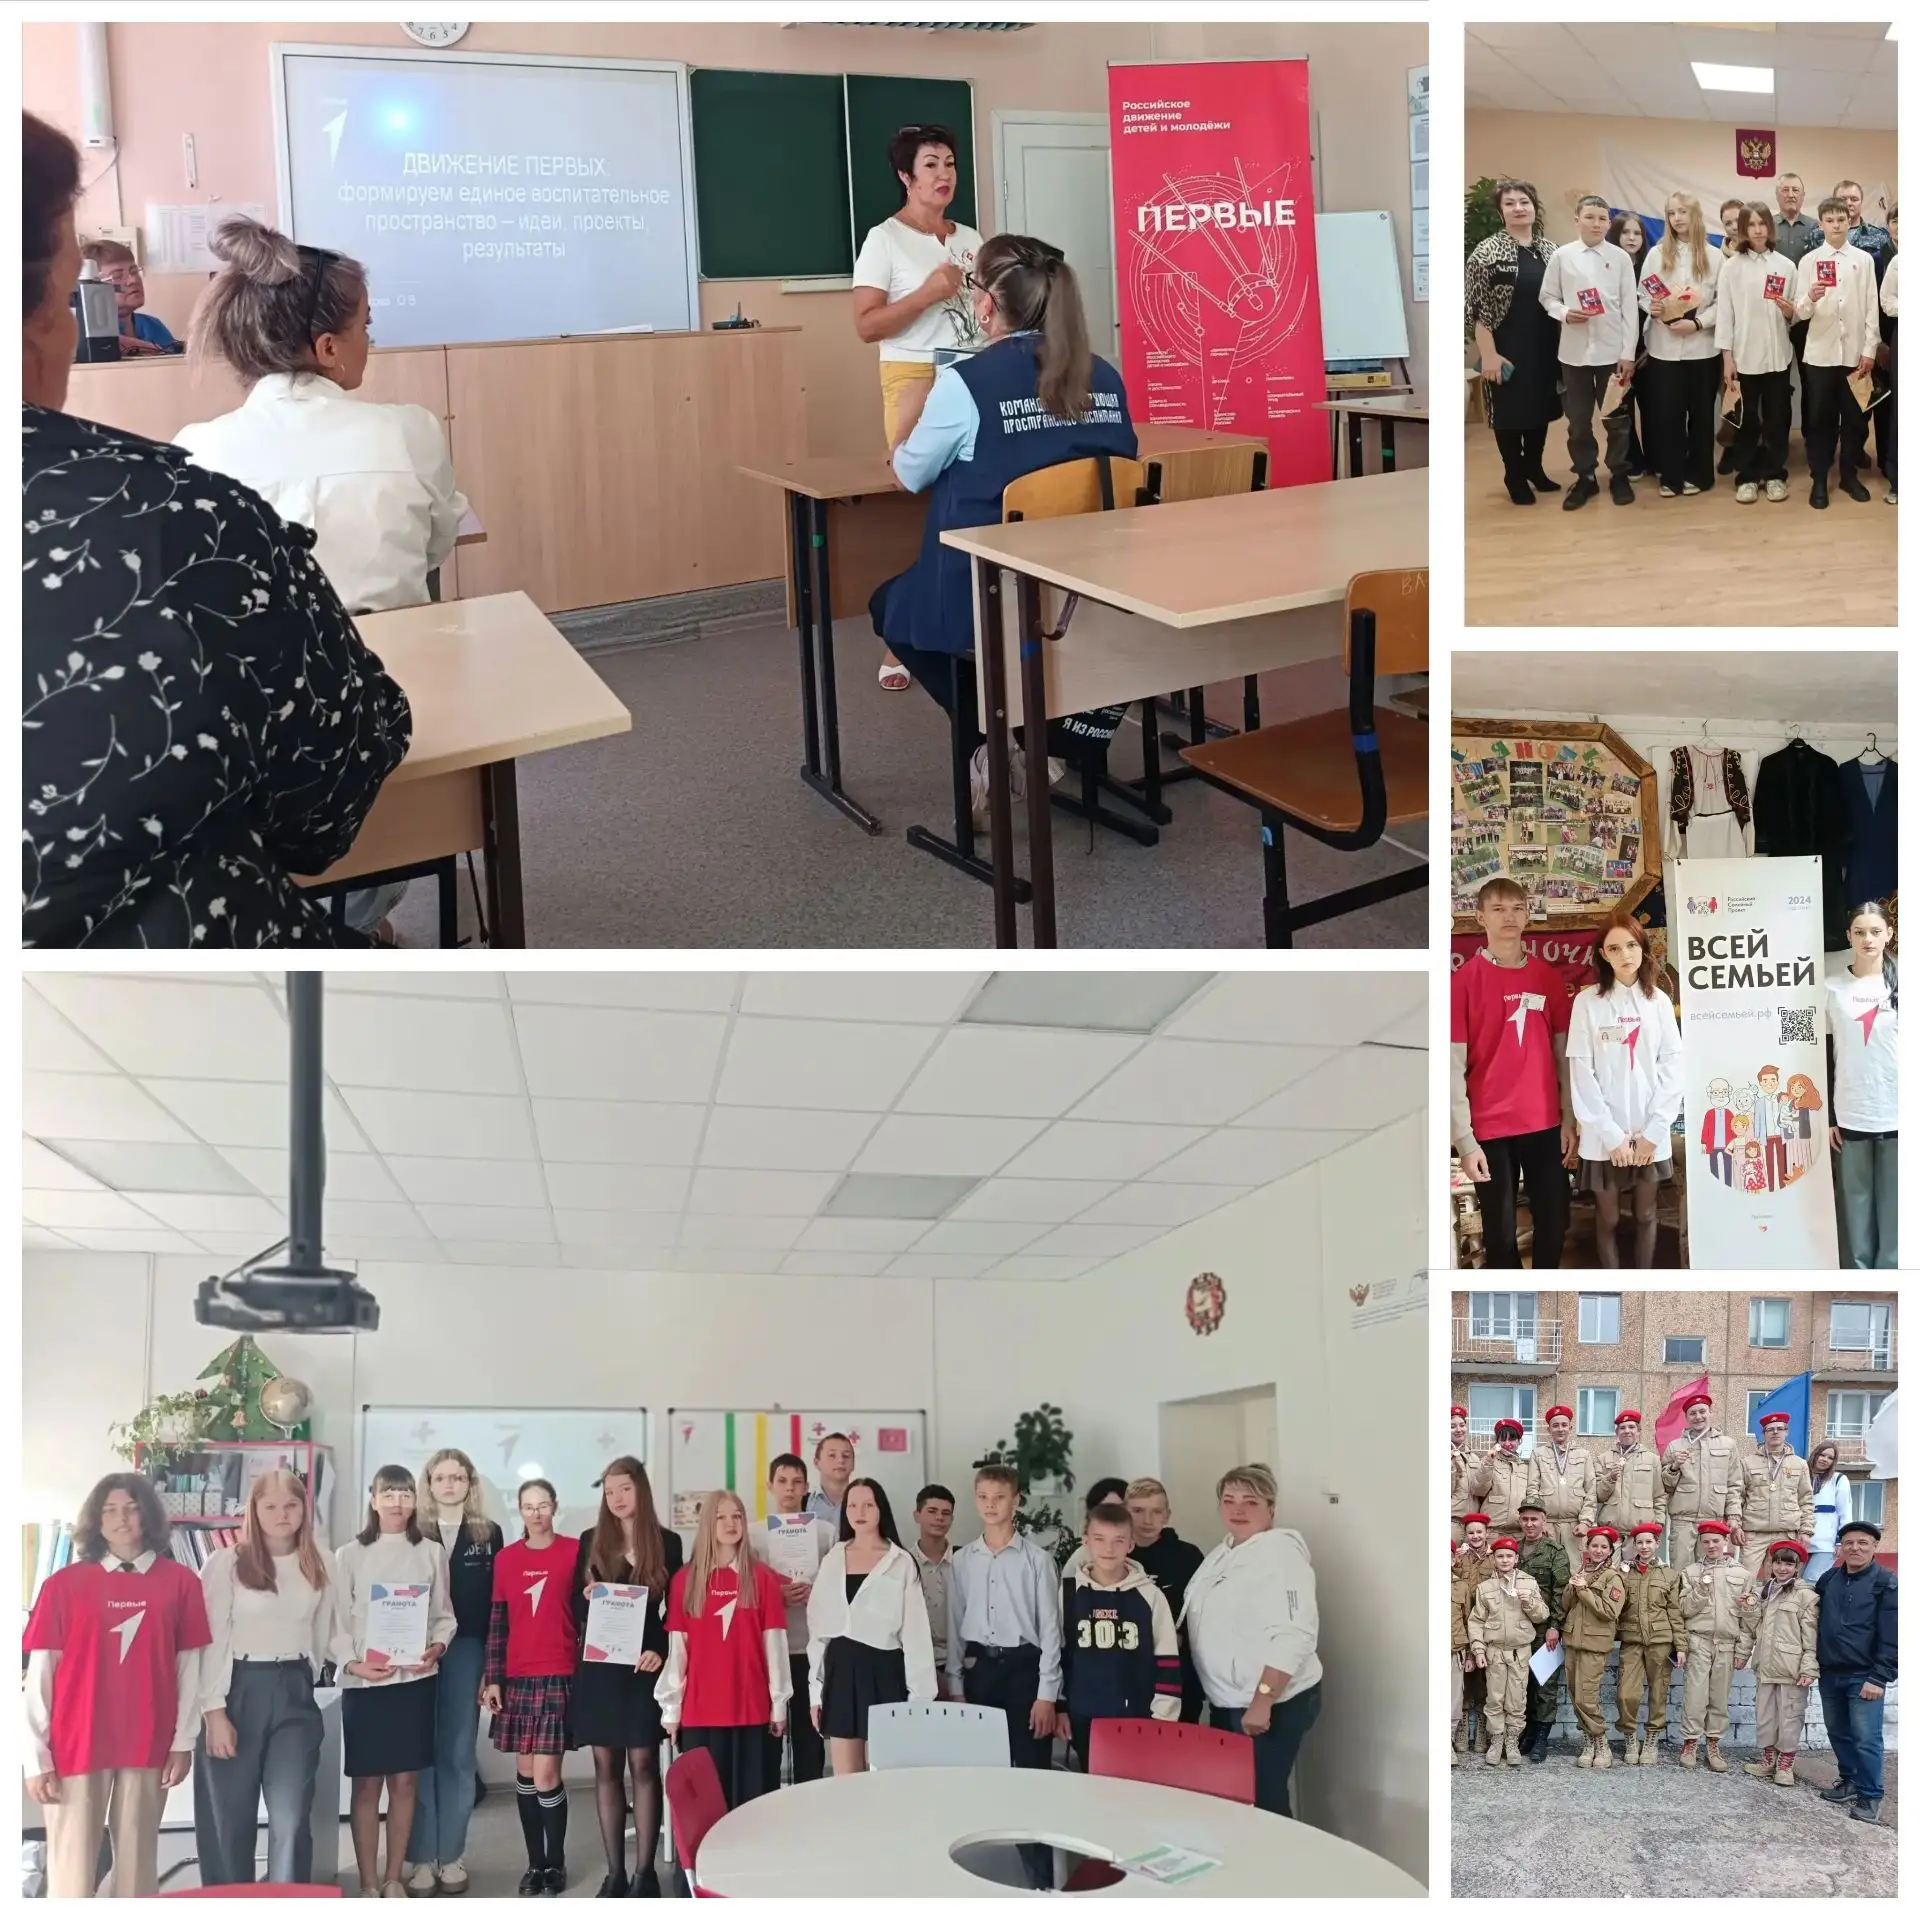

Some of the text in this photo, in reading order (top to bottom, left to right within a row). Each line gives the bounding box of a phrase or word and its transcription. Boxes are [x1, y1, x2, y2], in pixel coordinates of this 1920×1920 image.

[1122, 99, 1191, 110] Российское
[1122, 111, 1183, 123] движение
[1123, 120, 1231, 134] детей и молодёжи
[403, 152, 520, 177] ДВИЖЕНИЕ
[338, 184, 671, 208] формируем единое воспитательное
[366, 212, 497, 233] пространство
[1137, 199, 1296, 233] ПЕРВЫЕ
[462, 240, 566, 262] результаты
[1062, 717, 1114, 740] Я ИЗ РОССИ
[1788, 895, 1812, 905] 2024
[1687, 928, 1769, 961] ВСЕЙ
[1687, 956, 1815, 990] СЕМЬЕЙ
[1690, 1007, 1772, 1021] всейсемьей.рф
[711, 1589, 738, 1597] Первые
[107, 1600, 147, 1609] Первые
[381, 1600, 417, 1608] ГРАМОТА
[602, 1599, 635, 1608] ГРАМОТА
[1077, 1619, 1139, 1650] 303
